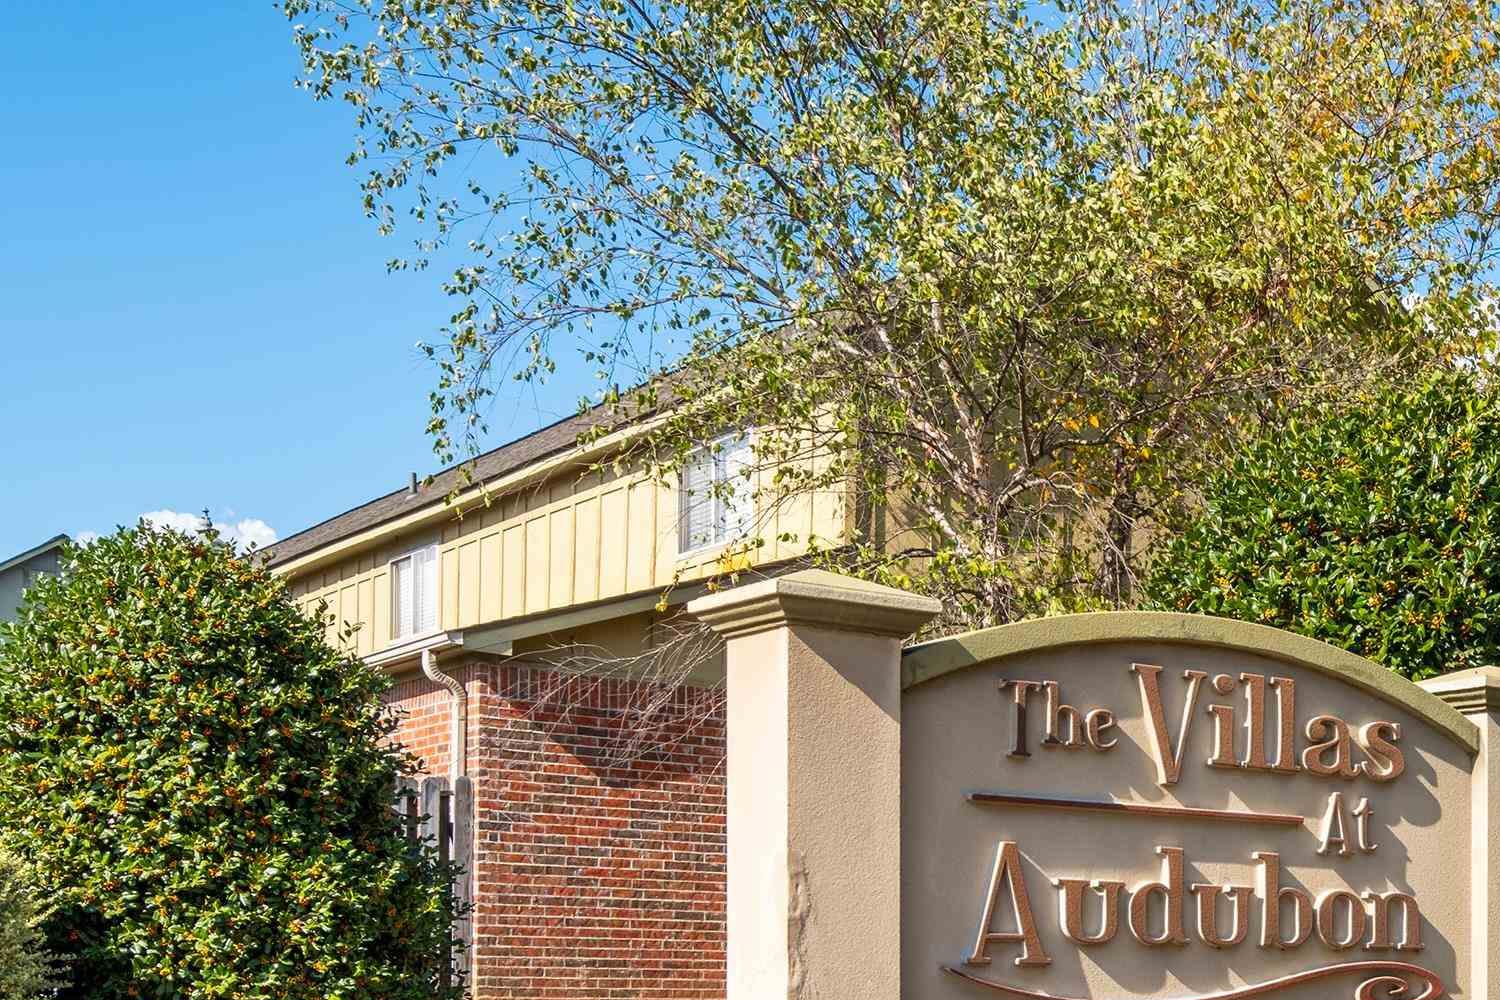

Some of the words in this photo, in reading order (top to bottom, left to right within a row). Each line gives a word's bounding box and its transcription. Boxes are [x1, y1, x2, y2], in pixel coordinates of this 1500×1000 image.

[998, 677, 1119, 758] The
[1128, 662, 1405, 785] Villas
[1316, 791, 1379, 856] At
[961, 840, 1425, 968] Audubon
